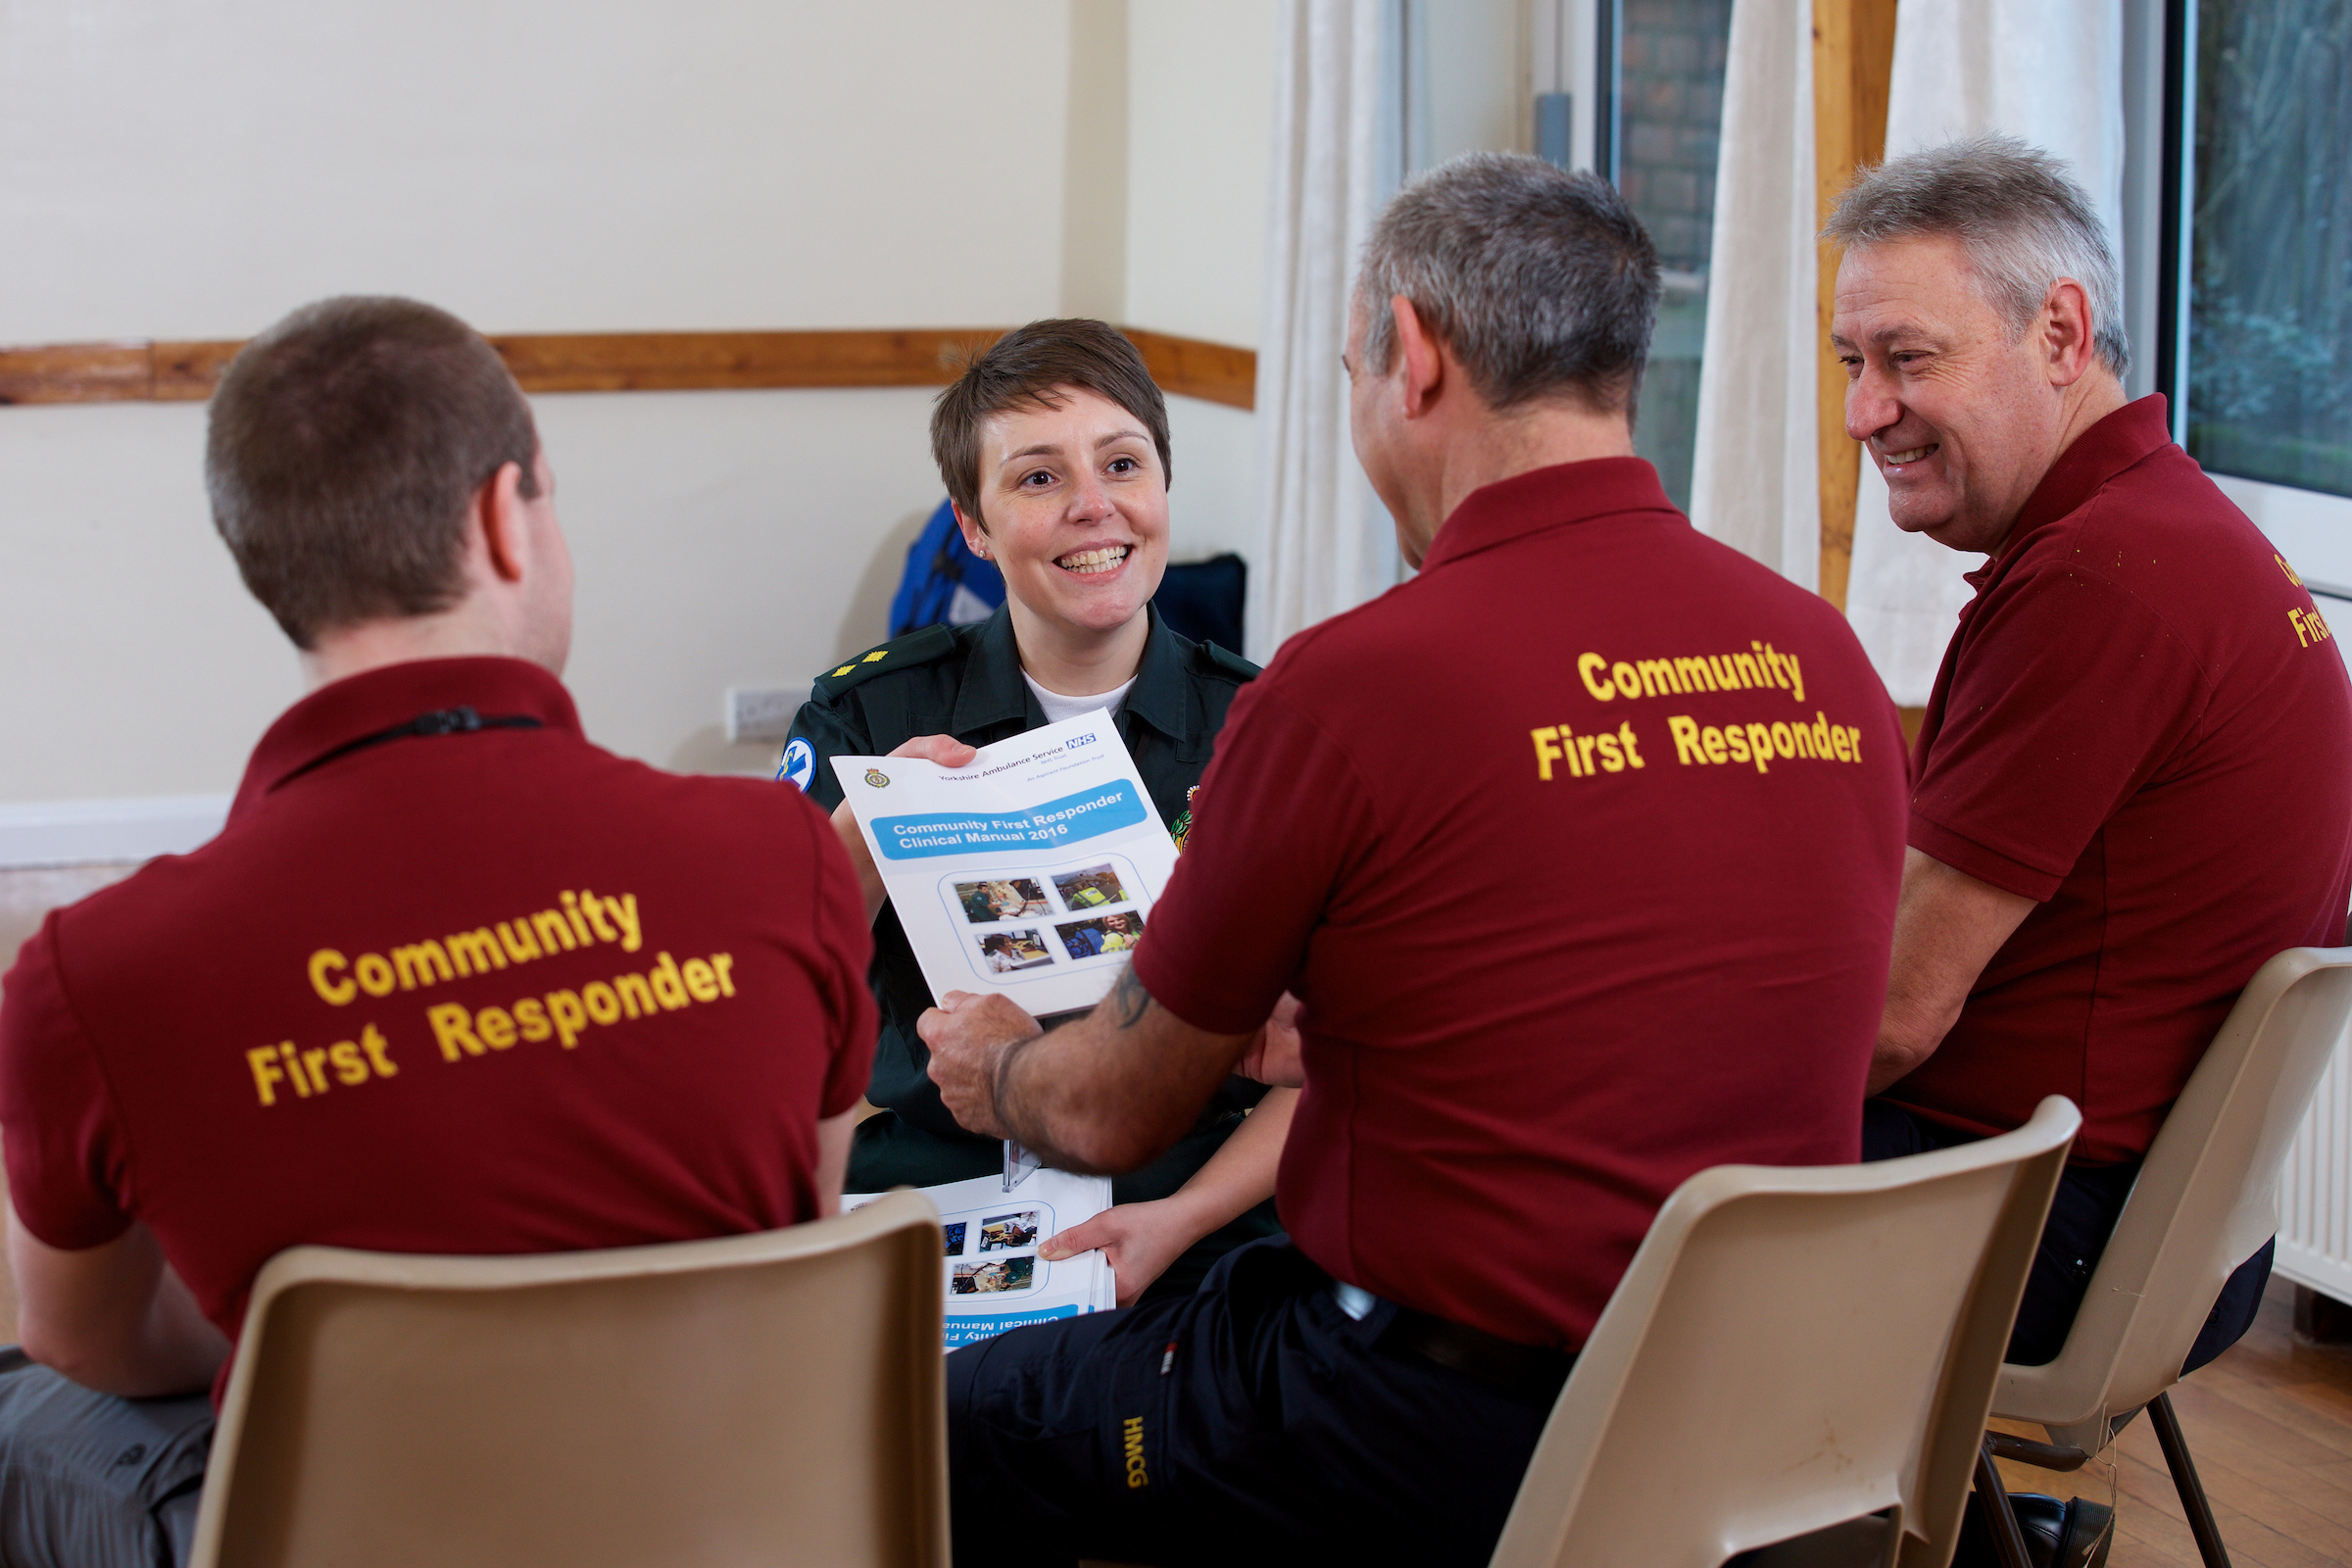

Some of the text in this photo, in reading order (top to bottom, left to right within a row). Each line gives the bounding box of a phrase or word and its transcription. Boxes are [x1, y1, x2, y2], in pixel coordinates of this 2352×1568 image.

[1578, 640, 1805, 703] Community
[982, 758, 1031, 777] Ambulance
[1032, 746, 1063, 760] Service
[1066, 733, 1097, 750] NHS
[1059, 759, 1090, 771] Foundation
[1530, 710, 1862, 781] First Responder
[894, 792, 1123, 836] Community First Responder
[900, 824, 1068, 850] Clinical Manual 2016
[306, 888, 643, 1006] Community
[245, 951, 736, 1106] First Responder
[942, 1322, 995, 1331] Manua
[1123, 1416, 1150, 1489] HMCG
